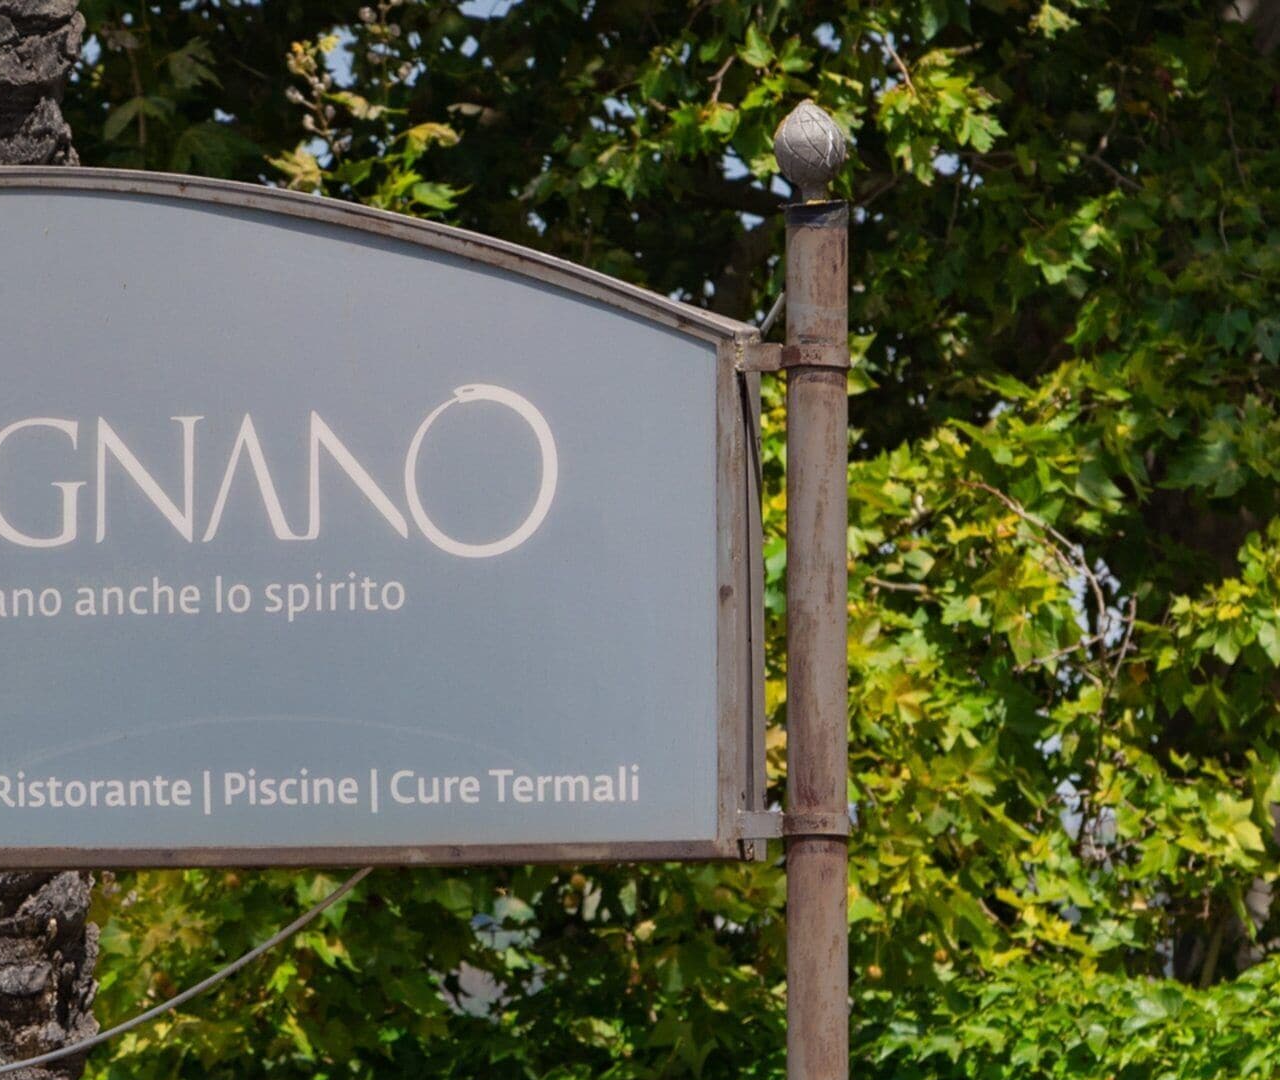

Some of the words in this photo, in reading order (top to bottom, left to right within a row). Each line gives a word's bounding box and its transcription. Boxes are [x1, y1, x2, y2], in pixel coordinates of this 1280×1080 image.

[75, 576, 202, 617] anche
[215, 575, 252, 614] lo
[264, 570, 406, 622] spirito
[223, 767, 360, 806] Piscine
[389, 769, 482, 804] Cure
[488, 764, 640, 803] Termali
